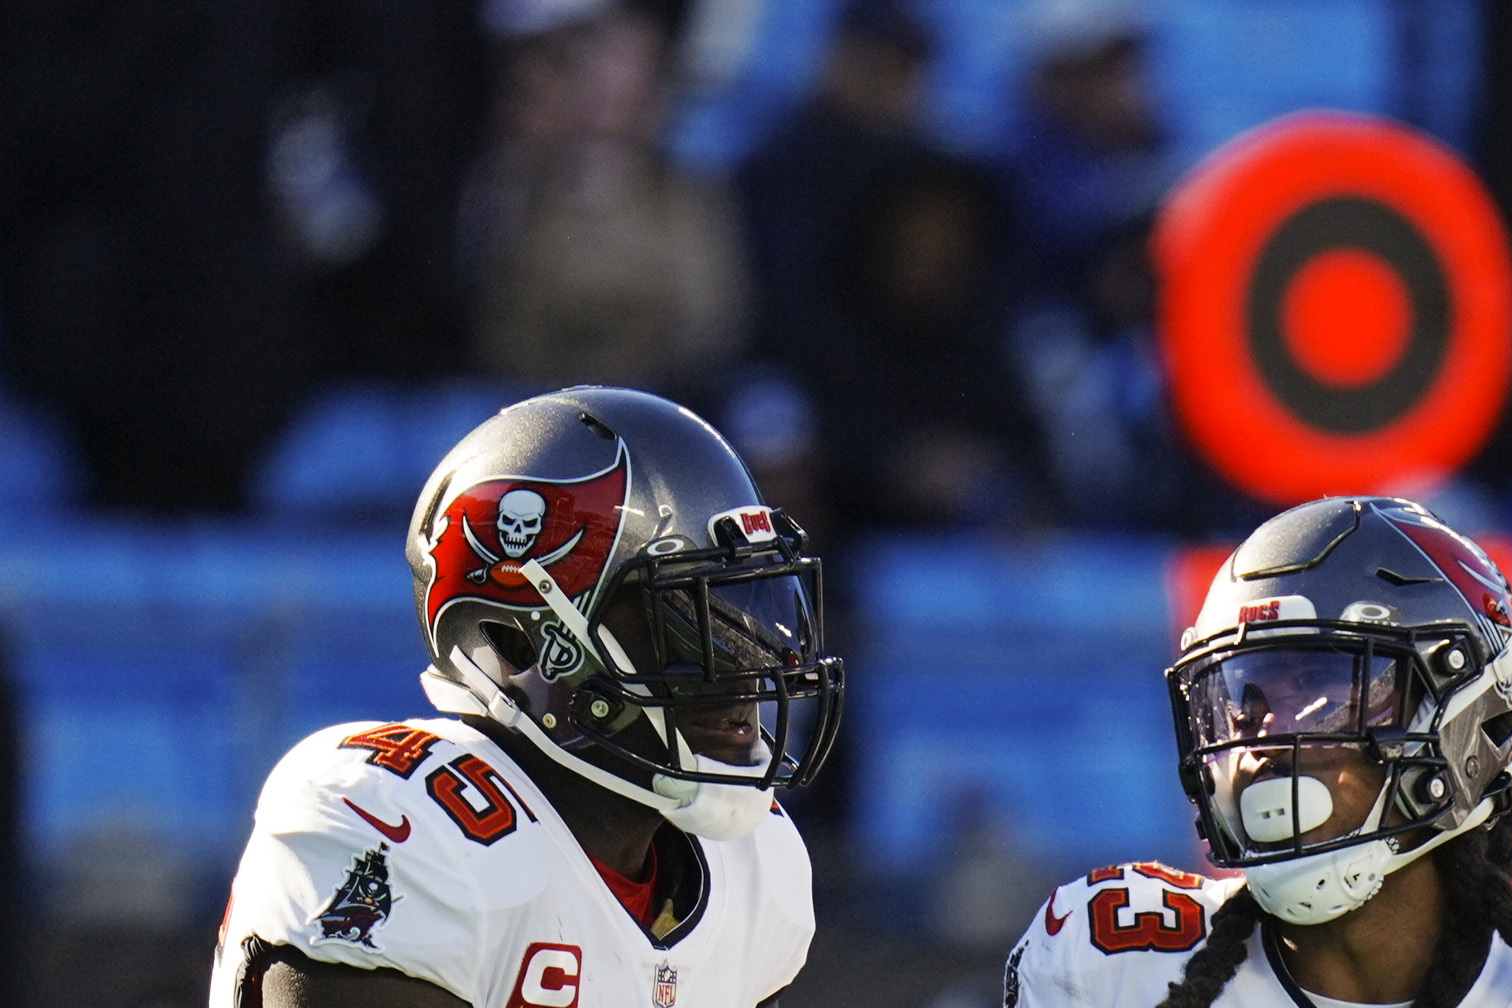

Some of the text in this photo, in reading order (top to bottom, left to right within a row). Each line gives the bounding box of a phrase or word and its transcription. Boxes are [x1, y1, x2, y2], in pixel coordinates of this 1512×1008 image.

[337, 724, 540, 846] 45
[521, 949, 579, 1008] C
[657, 984, 676, 1006] NFL
